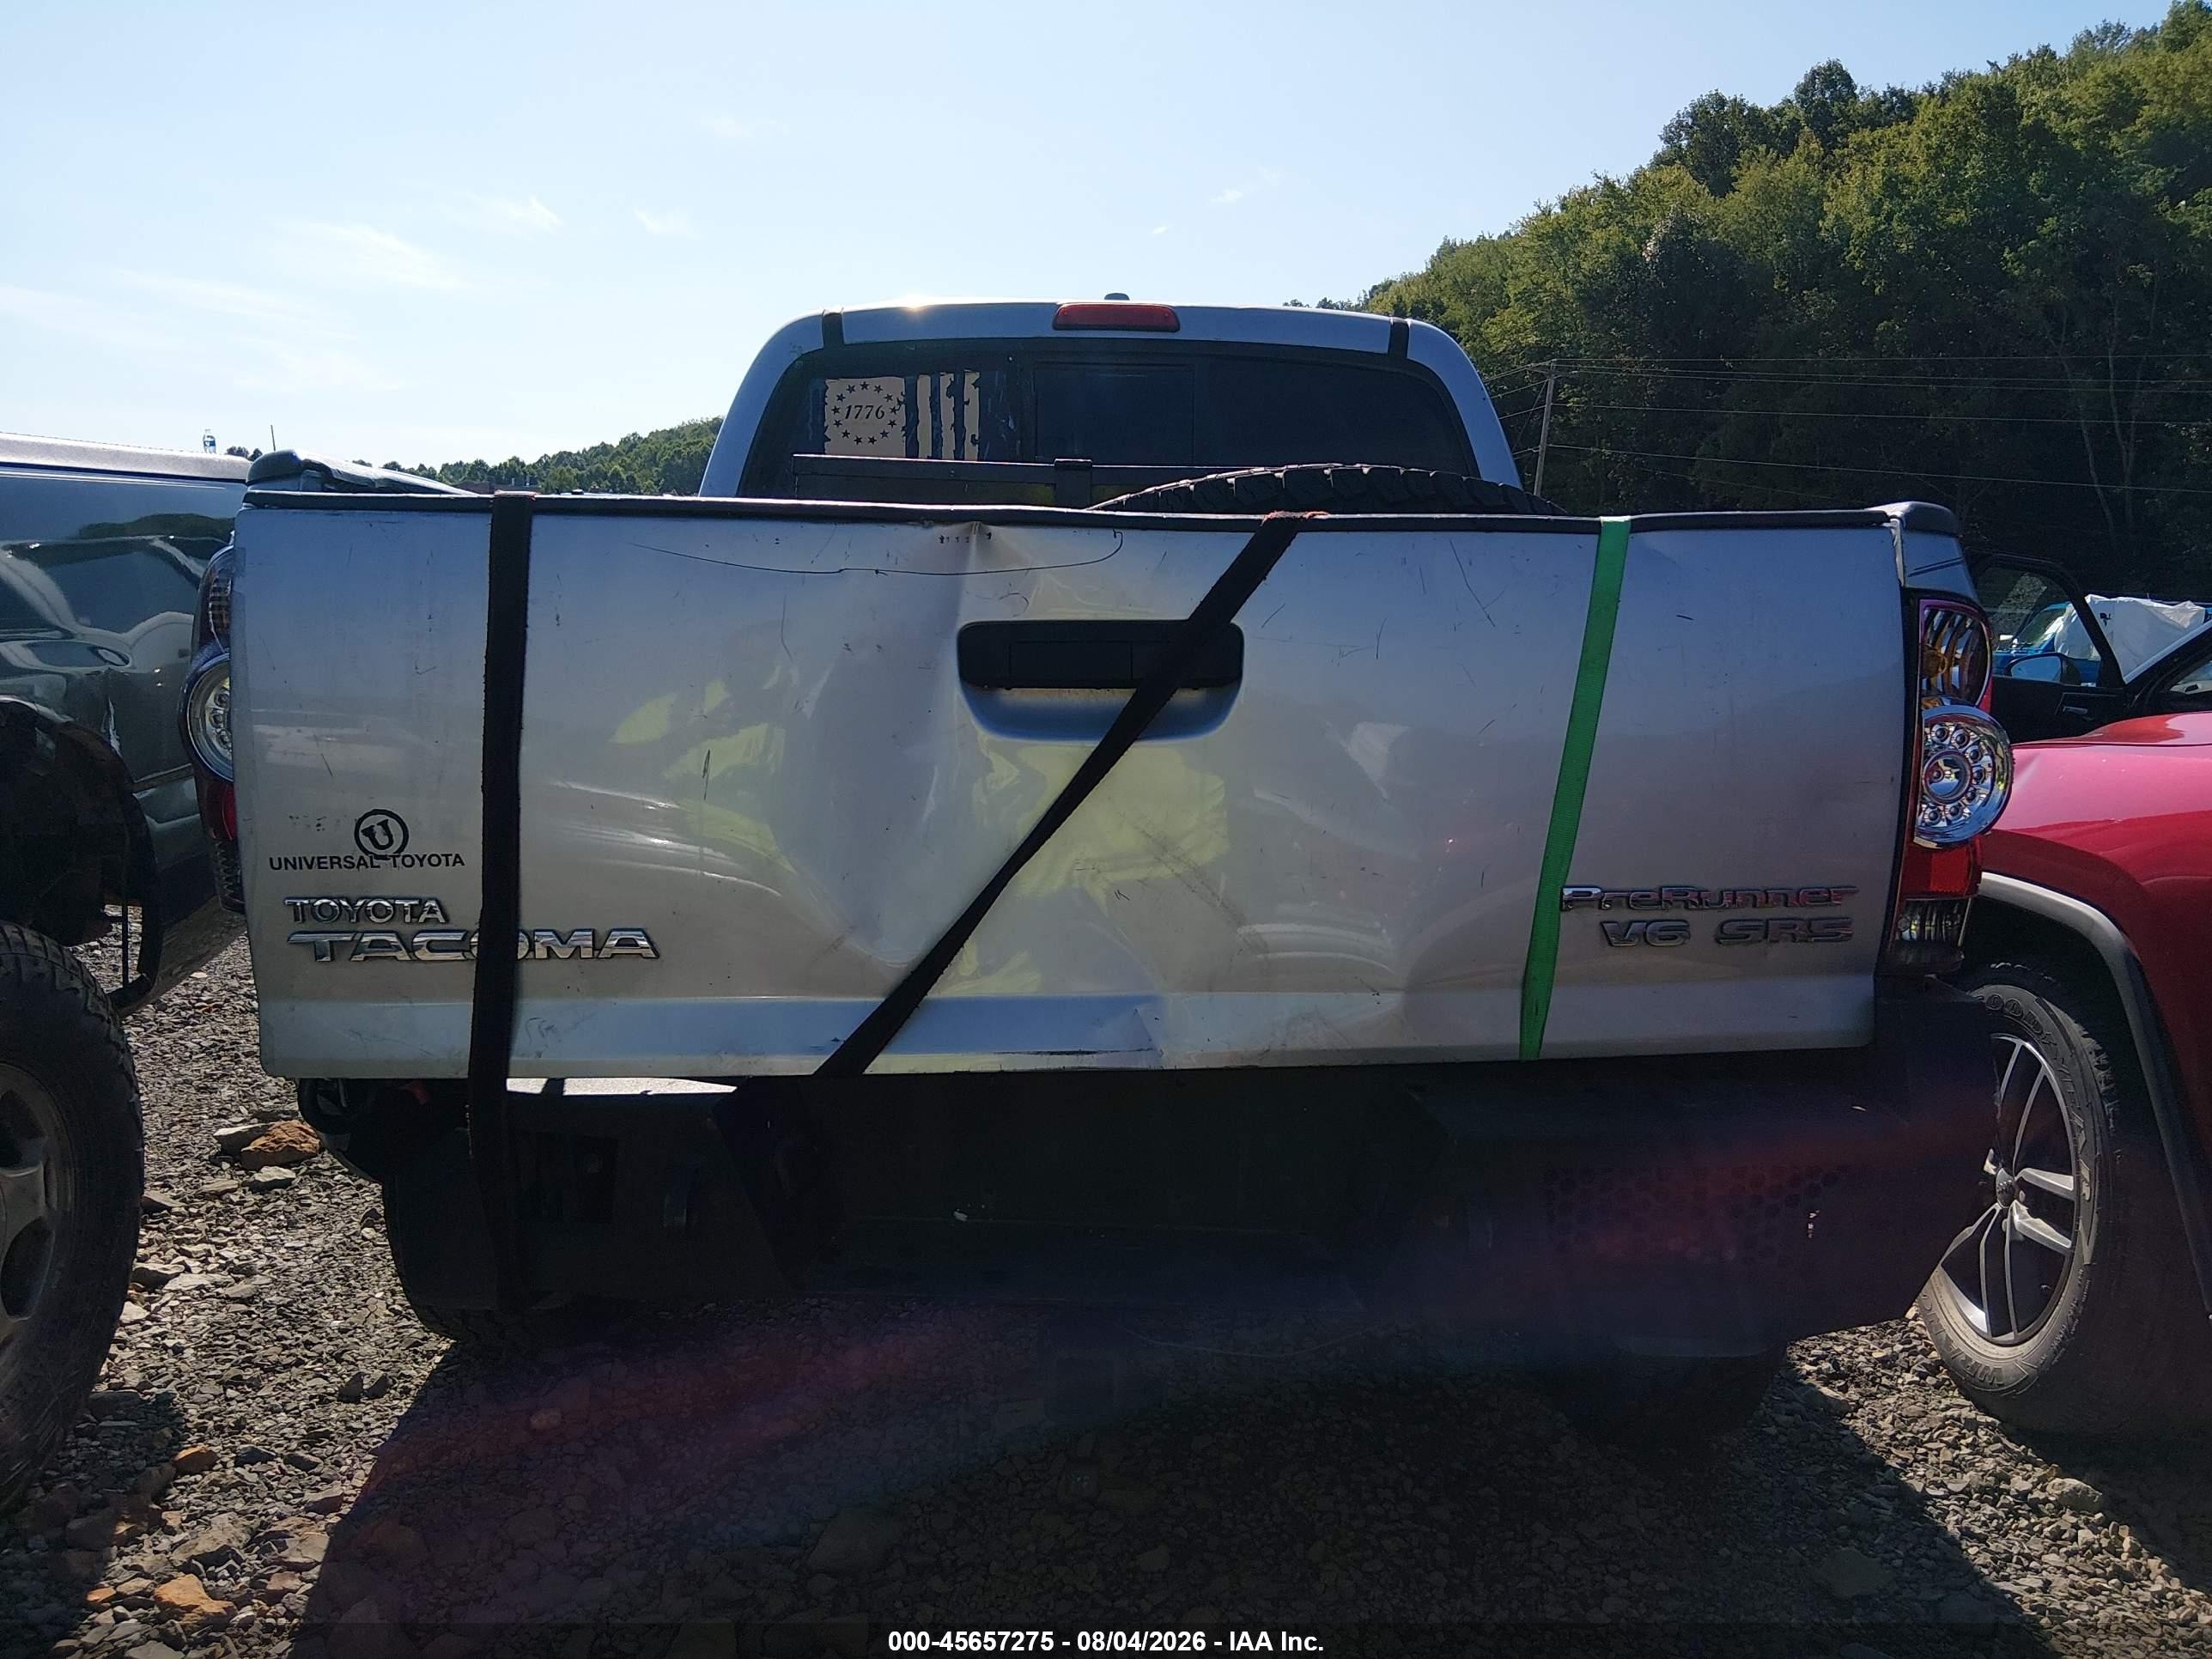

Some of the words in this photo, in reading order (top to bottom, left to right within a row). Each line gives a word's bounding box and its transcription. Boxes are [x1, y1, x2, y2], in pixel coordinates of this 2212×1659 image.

[845, 404, 885, 420] 1776
[269, 856, 380, 871] UNIVERSAL
[389, 853, 465, 868] TOYOTA
[284, 896, 449, 924] TOYOTA
[1561, 885, 1859, 911] PreRunner
[1601, 919, 1691, 947] V6
[1715, 917, 1855, 945] SR5
[1975, 994, 2092, 1201] OODYEAR
